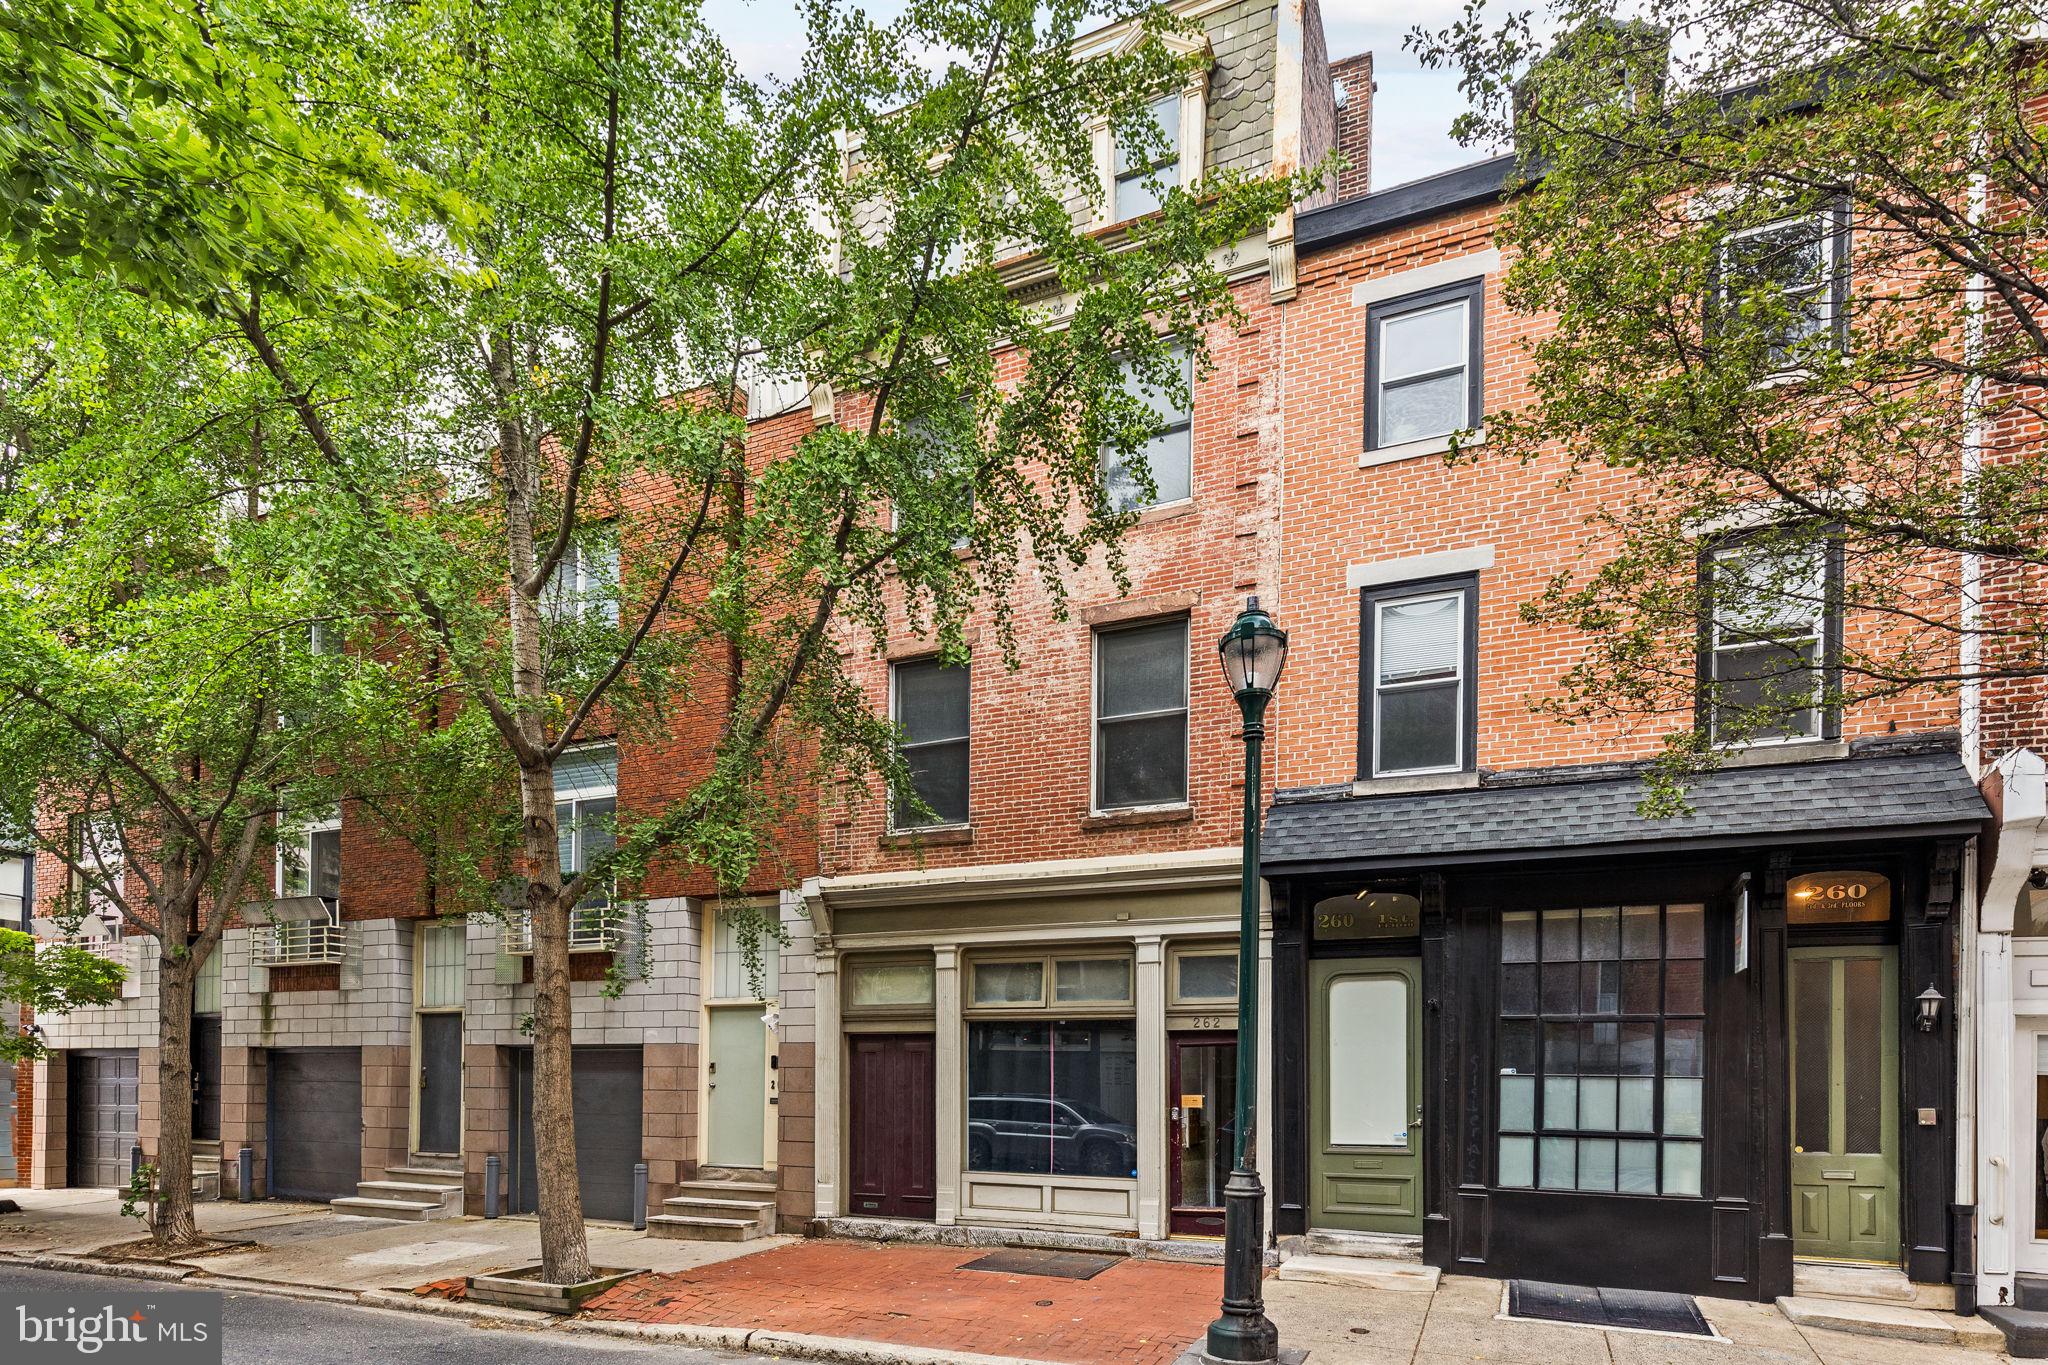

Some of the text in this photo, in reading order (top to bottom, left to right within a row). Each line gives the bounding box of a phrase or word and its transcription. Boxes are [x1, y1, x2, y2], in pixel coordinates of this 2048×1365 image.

[1804, 884, 1867, 901] 260
[1318, 913, 1354, 928] 260
[1193, 1017, 1220, 1028] 262
